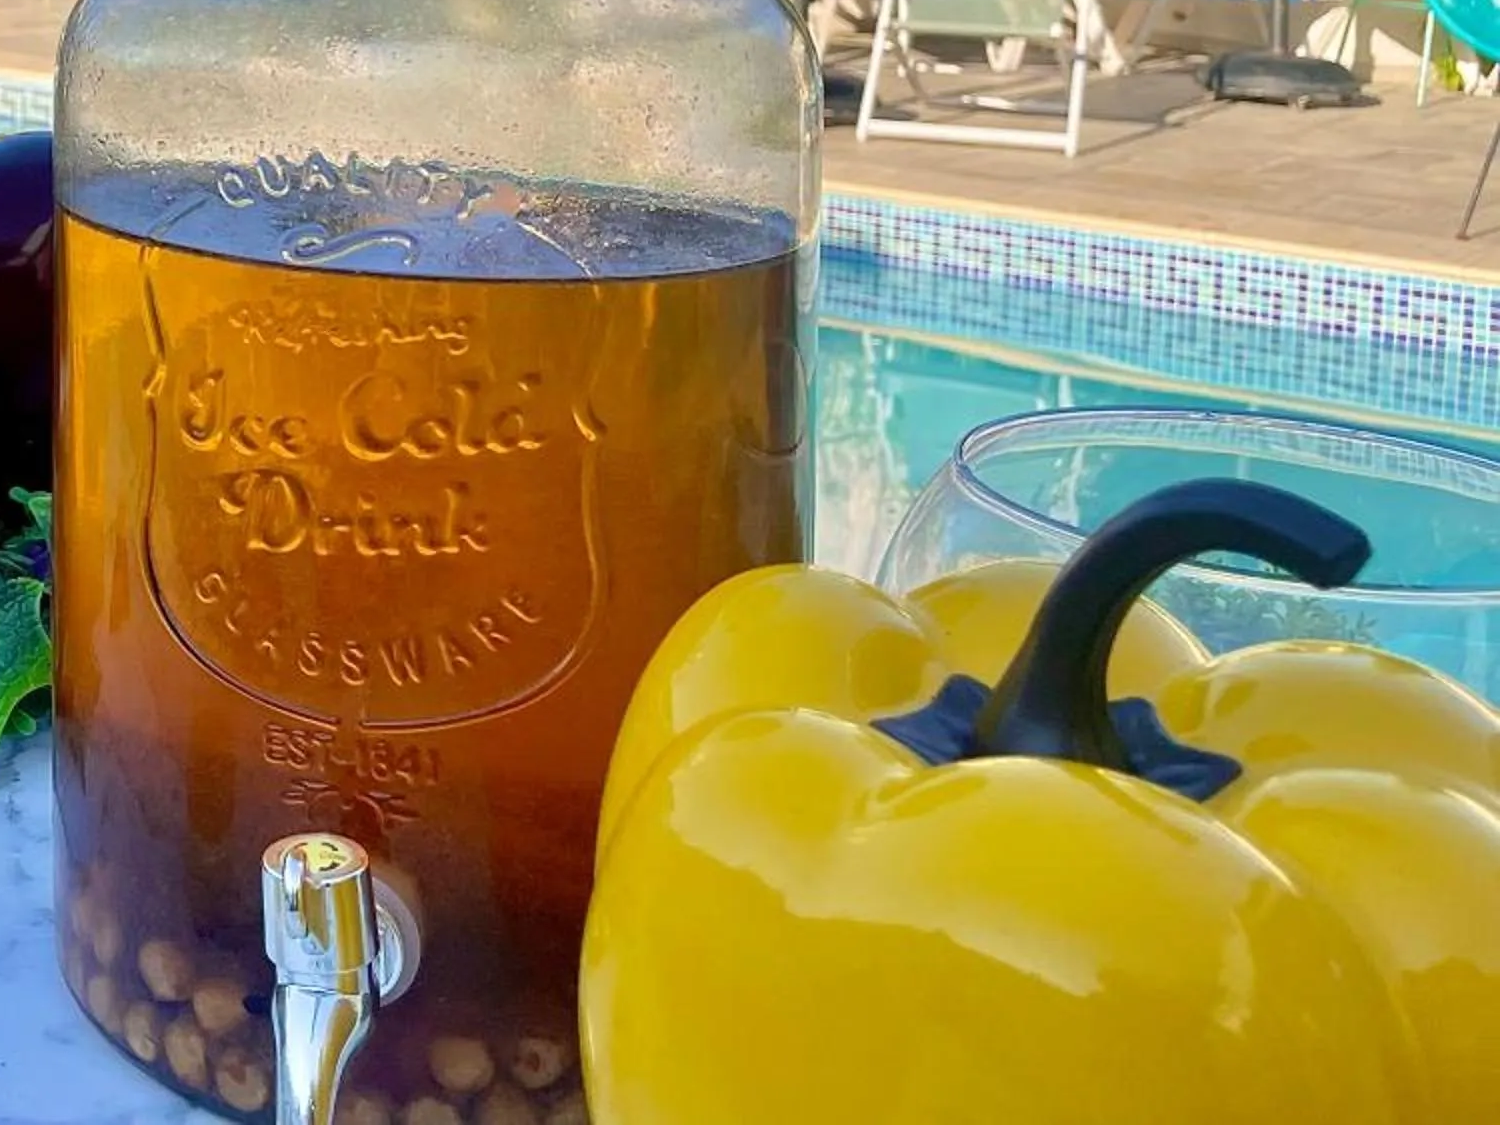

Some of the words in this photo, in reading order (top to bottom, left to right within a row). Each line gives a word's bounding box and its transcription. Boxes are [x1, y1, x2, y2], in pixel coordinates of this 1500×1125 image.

[216, 148, 494, 221] QUALITY
[178, 369, 309, 459] Ice
[338, 373, 545, 462] Cold
[216, 469, 494, 557] Drink
[193, 572, 543, 687] GLASSWARE
